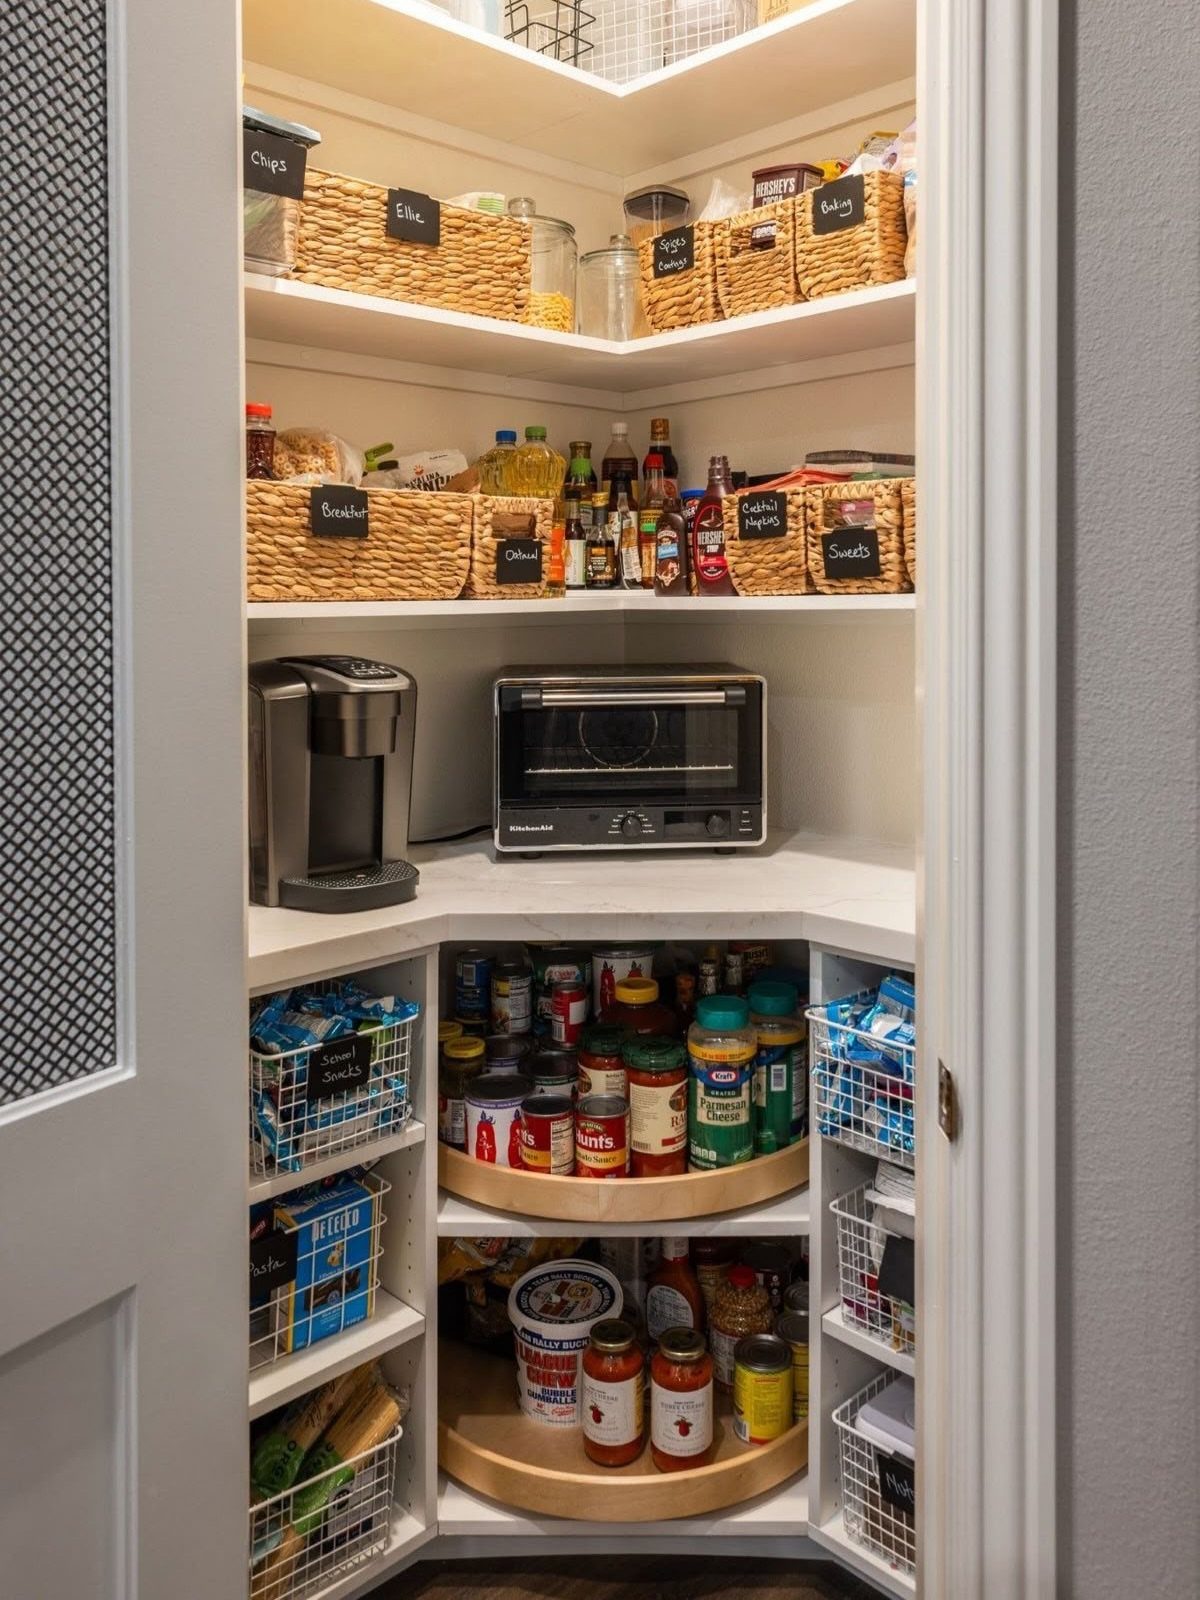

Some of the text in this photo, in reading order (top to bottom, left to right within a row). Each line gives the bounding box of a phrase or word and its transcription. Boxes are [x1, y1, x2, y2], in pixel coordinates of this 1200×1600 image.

[251, 150, 288, 174] Chips
[755, 177, 796, 199] HERSHEY'S
[396, 202, 425, 224] Ellie
[820, 197, 853, 217] Baking
[321, 502, 369, 521] Breakfast
[742, 499, 778, 514] Cocktail
[745, 514, 781, 531] Napkins
[828, 543, 871, 559] Sweets
[509, 824, 554, 833] KitchenAid
[320, 1045, 356, 1067] School
[322, 1065, 363, 1083] Snacks
[715, 1072, 734, 1081] Kraft
[700, 1097, 746, 1111] Parmesan
[706, 1109, 741, 1122] Cheese
[593, 1154, 617, 1163] Sauce
[249, 1256, 287, 1277] Pasta
[532, 1338, 561, 1349] RALLY
[562, 1338, 588, 1349] BUCK
[526, 1365, 577, 1389] CHEW
[527, 1389, 577, 1405] GUMBALLS
[541, 1388, 577, 1398] BUBBLE
